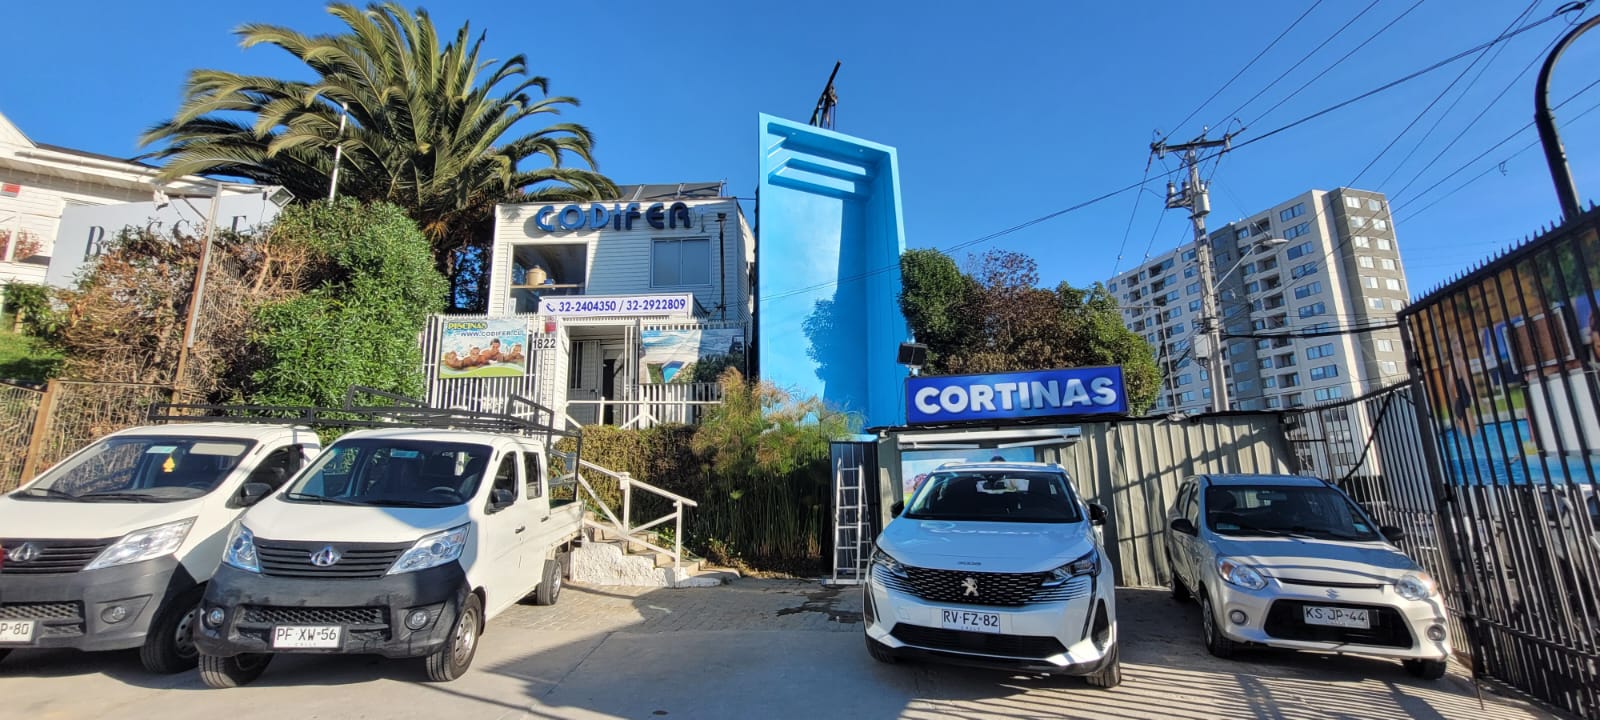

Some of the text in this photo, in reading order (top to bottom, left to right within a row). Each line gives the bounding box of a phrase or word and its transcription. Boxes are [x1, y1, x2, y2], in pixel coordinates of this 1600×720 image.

[535, 201, 691, 232] CODIFER
[559, 301, 616, 312] 32-2404350
[626, 299, 686, 310] 32-2922809
[447, 321, 488, 330] PISCINAS
[533, 338, 556, 349] 1822
[914, 377, 1117, 414] CORTINAS
